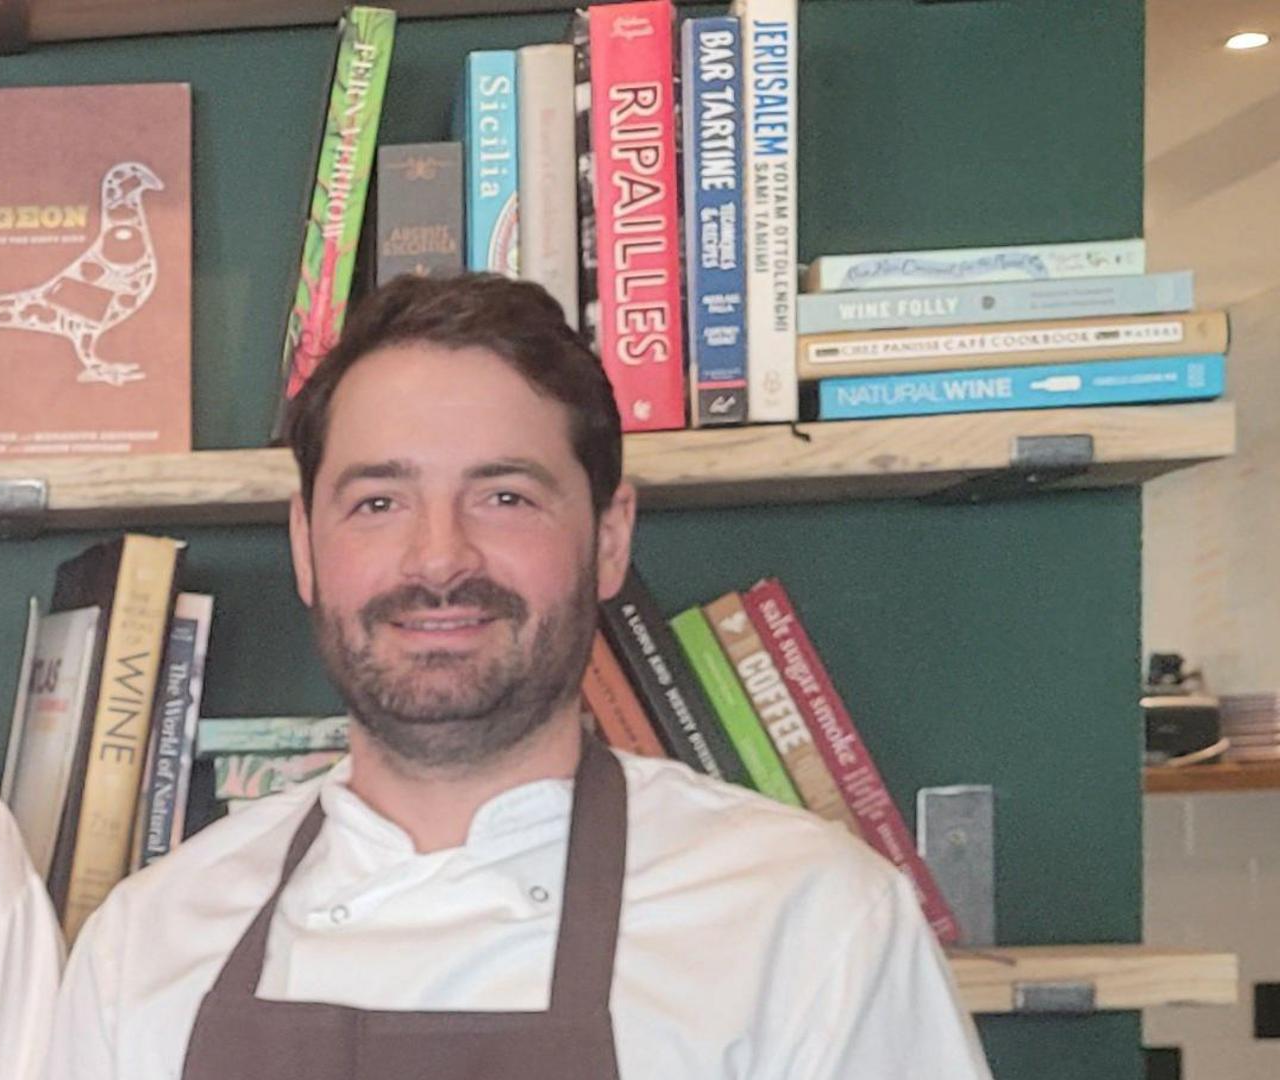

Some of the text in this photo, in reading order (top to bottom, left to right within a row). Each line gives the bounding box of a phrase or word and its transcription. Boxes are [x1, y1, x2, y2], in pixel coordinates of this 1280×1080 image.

[480, 75, 511, 198] Sicilia
[699, 30, 737, 191] BAR TARTINE
[753, 20, 789, 156] JERUSALEM
[773, 162, 788, 218] YOTAM
[608, 81, 670, 365] RIPAILLES
[755, 162, 769, 273] SAMI TAMIMI
[840, 297, 959, 320] WINE FOLLY
[99, 652, 150, 765] WINE
[161, 694, 184, 758] World
[166, 661, 188, 694] The
[739, 651, 813, 754] COFFEE
[758, 599, 858, 766] salt sugar smoke
[147, 780, 174, 852] Natural
[156, 758, 176, 778] of
